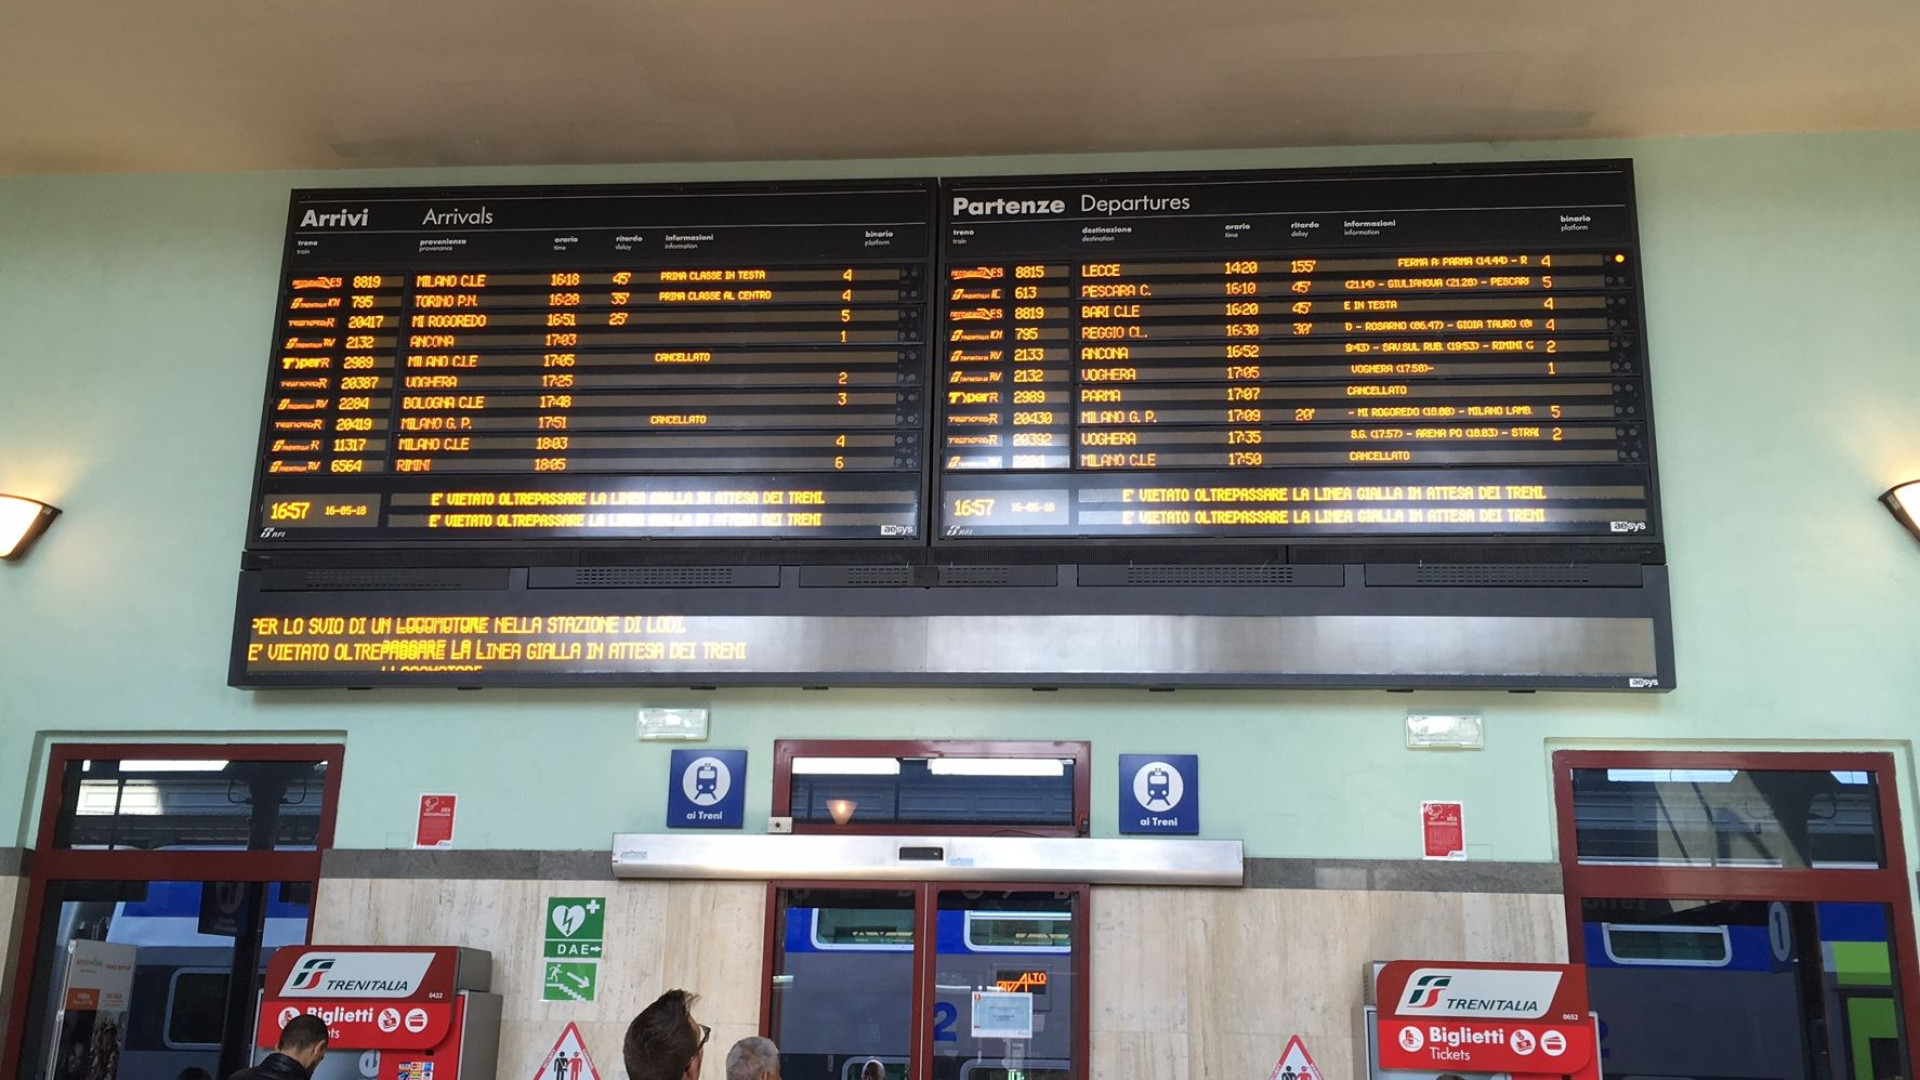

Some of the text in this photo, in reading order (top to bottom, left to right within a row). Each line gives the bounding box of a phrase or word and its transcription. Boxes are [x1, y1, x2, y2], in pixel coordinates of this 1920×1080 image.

[952, 197, 1066, 216] Partenze
[1081, 195, 1191, 215] Departures
[300, 208, 368, 228] Arrivi
[422, 206, 494, 225] Arrivals
[1560, 215, 1592, 224] binario
[1082, 226, 1132, 234] destinazione
[1225, 223, 1251, 231] orario
[1291, 221, 1320, 229] ritardo
[1344, 220, 1396, 229] informazioni
[1561, 224, 1589, 233] platform
[616, 234, 643, 243] ritardo
[665, 234, 714, 242] informazioni
[865, 230, 894, 239] binario
[1082, 235, 1115, 243] destination
[1344, 228, 1380, 237] information
[298, 239, 318, 247] treno
[420, 237, 467, 247] provenienza
[554, 235, 579, 244] orario
[1291, 261, 1316, 273] 155'
[1398, 257, 1473, 267] FERMA PARMA
[1541, 255, 1551, 267] 4
[1015, 265, 1045, 279] 8815
[1082, 264, 1121, 277] LECCE
[1225, 261, 1258, 275] 14:20
[353, 275, 382, 289] 8819
[416, 275, 457, 288] MILANO
[551, 273, 580, 286] 16:18
[661, 270, 766, 281] PRIMA CLASSE TESTA
[843, 270, 852, 281] 4
[1542, 276, 1552, 288] 5
[1014, 286, 1038, 300] 613
[1082, 285, 1136, 297] PESCARA
[1225, 282, 1257, 295] 16:10
[351, 295, 374, 309] 795
[415, 295, 454, 308] TORINO
[549, 293, 580, 306] 16:28
[659, 290, 772, 302] PRIMA CLASSE CENTRO
[842, 290, 851, 301] 4
[1226, 302, 1259, 316] 16:20
[1368, 300, 1398, 310] TESTA
[1543, 298, 1554, 310] 4
[841, 310, 850, 321] 5
[1014, 306, 1044, 320] 8819
[1082, 306, 1109, 318] BARI
[348, 315, 384, 329] 20417
[412, 314, 487, 328] MI ROGOREDO
[547, 313, 576, 327] 16:51
[1486, 319, 1517, 329] TAURO
[1545, 319, 1555, 331] 4
[1014, 327, 1039, 341] 795
[1082, 326, 1125, 339] REGGIO
[1226, 323, 1259, 337] 16:30
[1293, 323, 1312, 335] 30'
[345, 335, 375, 349] 2132
[410, 335, 455, 348] ANCONA
[546, 333, 577, 346] 17:03
[1492, 341, 1524, 350] RIMINI
[1082, 347, 1129, 359] ANCONA
[1226, 344, 1260, 358] 16:52
[1546, 340, 1556, 353] 2
[544, 353, 575, 367] 17:05
[655, 352, 711, 363] CANCELLATO
[1014, 347, 1044, 362] 2133
[343, 356, 374, 369] 2989
[1352, 364, 1393, 374] VOGHERA
[1548, 362, 1556, 375] 1
[1014, 368, 1044, 383] 2132
[1082, 368, 1137, 381] VOGHERA
[1227, 366, 1260, 379] 17:05
[341, 376, 379, 390] 20387
[542, 374, 574, 387] 17:25
[1013, 390, 1046, 404] 2989
[1081, 389, 1121, 402] PARMA
[1227, 387, 1261, 401] 17:07
[1347, 385, 1408, 396] CANCELLATO
[338, 396, 370, 410] 2284
[403, 396, 455, 410] BOLOGNA
[539, 395, 572, 408] 17:48
[1013, 411, 1053, 425] 20430
[1081, 411, 1124, 424] MILANO
[1228, 408, 1261, 422] 17:09
[1295, 409, 1316, 421] 20'
[1371, 406, 1503, 417] ROGOREDO MILANO
[1550, 406, 1561, 418] 5
[335, 417, 373, 431] 20419
[401, 417, 443, 431] MILANO
[538, 416, 567, 429] 17:51
[650, 415, 707, 425] CANCELLATO
[1082, 432, 1137, 446] VOGHERA
[1228, 430, 1262, 444] 17:35
[1415, 428, 1447, 438] ARENA
[1552, 428, 1563, 441] 2
[333, 438, 367, 452] 11317
[398, 438, 440, 451] MILANO
[536, 436, 569, 450] 18:03
[1081, 454, 1125, 467] MILANO
[1229, 452, 1263, 466] 17:50
[1349, 451, 1411, 461] CANCELLATO
[330, 459, 363, 473] 6564
[396, 458, 432, 472] RIMINI
[535, 458, 567, 471] 18:05
[1138, 486, 1501, 502] VIETATO OLTREPASSARE LA LINEA GIALLA ATTESA DEI
[270, 501, 311, 520] 16:57
[954, 500, 996, 517] 16:57
[283, 616, 643, 635] LO SVIO DI UN NELLA STAZIONE DI
[247, 642, 748, 661] E' VIETATO GIALLA IN ATTESA DEI TRENI
[686, 811, 723, 820] ai Treni
[1140, 817, 1178, 828] ai Treni
[557, 943, 590, 956] DAE
[326, 979, 409, 992] TRENITALIA
[1446, 998, 1539, 1013] TRENITALIA
[935, 1001, 958, 1042] 2
[1430, 1026, 1505, 1048] Biglietti
[1430, 1046, 1471, 1061] Tickets
